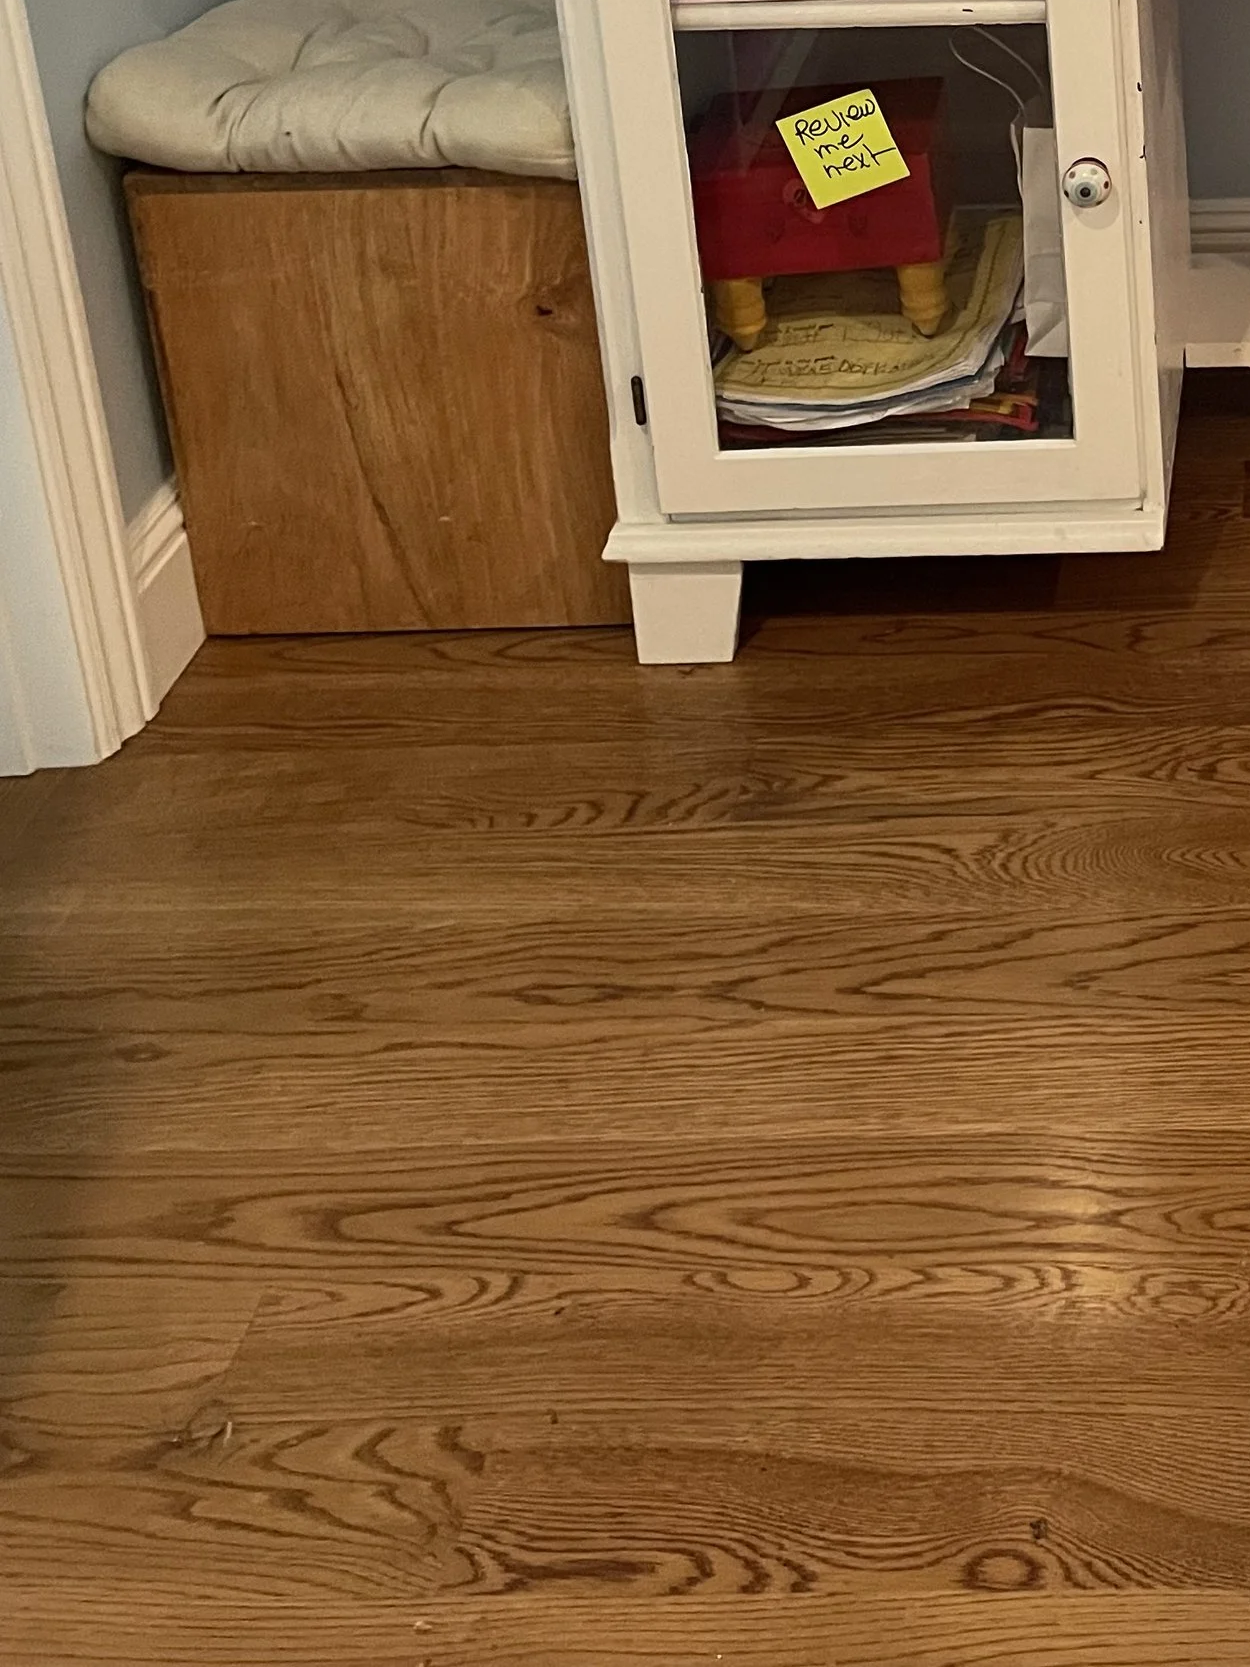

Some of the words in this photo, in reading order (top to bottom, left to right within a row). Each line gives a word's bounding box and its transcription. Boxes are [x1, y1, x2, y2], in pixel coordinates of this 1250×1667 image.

[794, 99, 876, 145] Review
[814, 134, 864, 159] me
[823, 144, 897, 179] next
